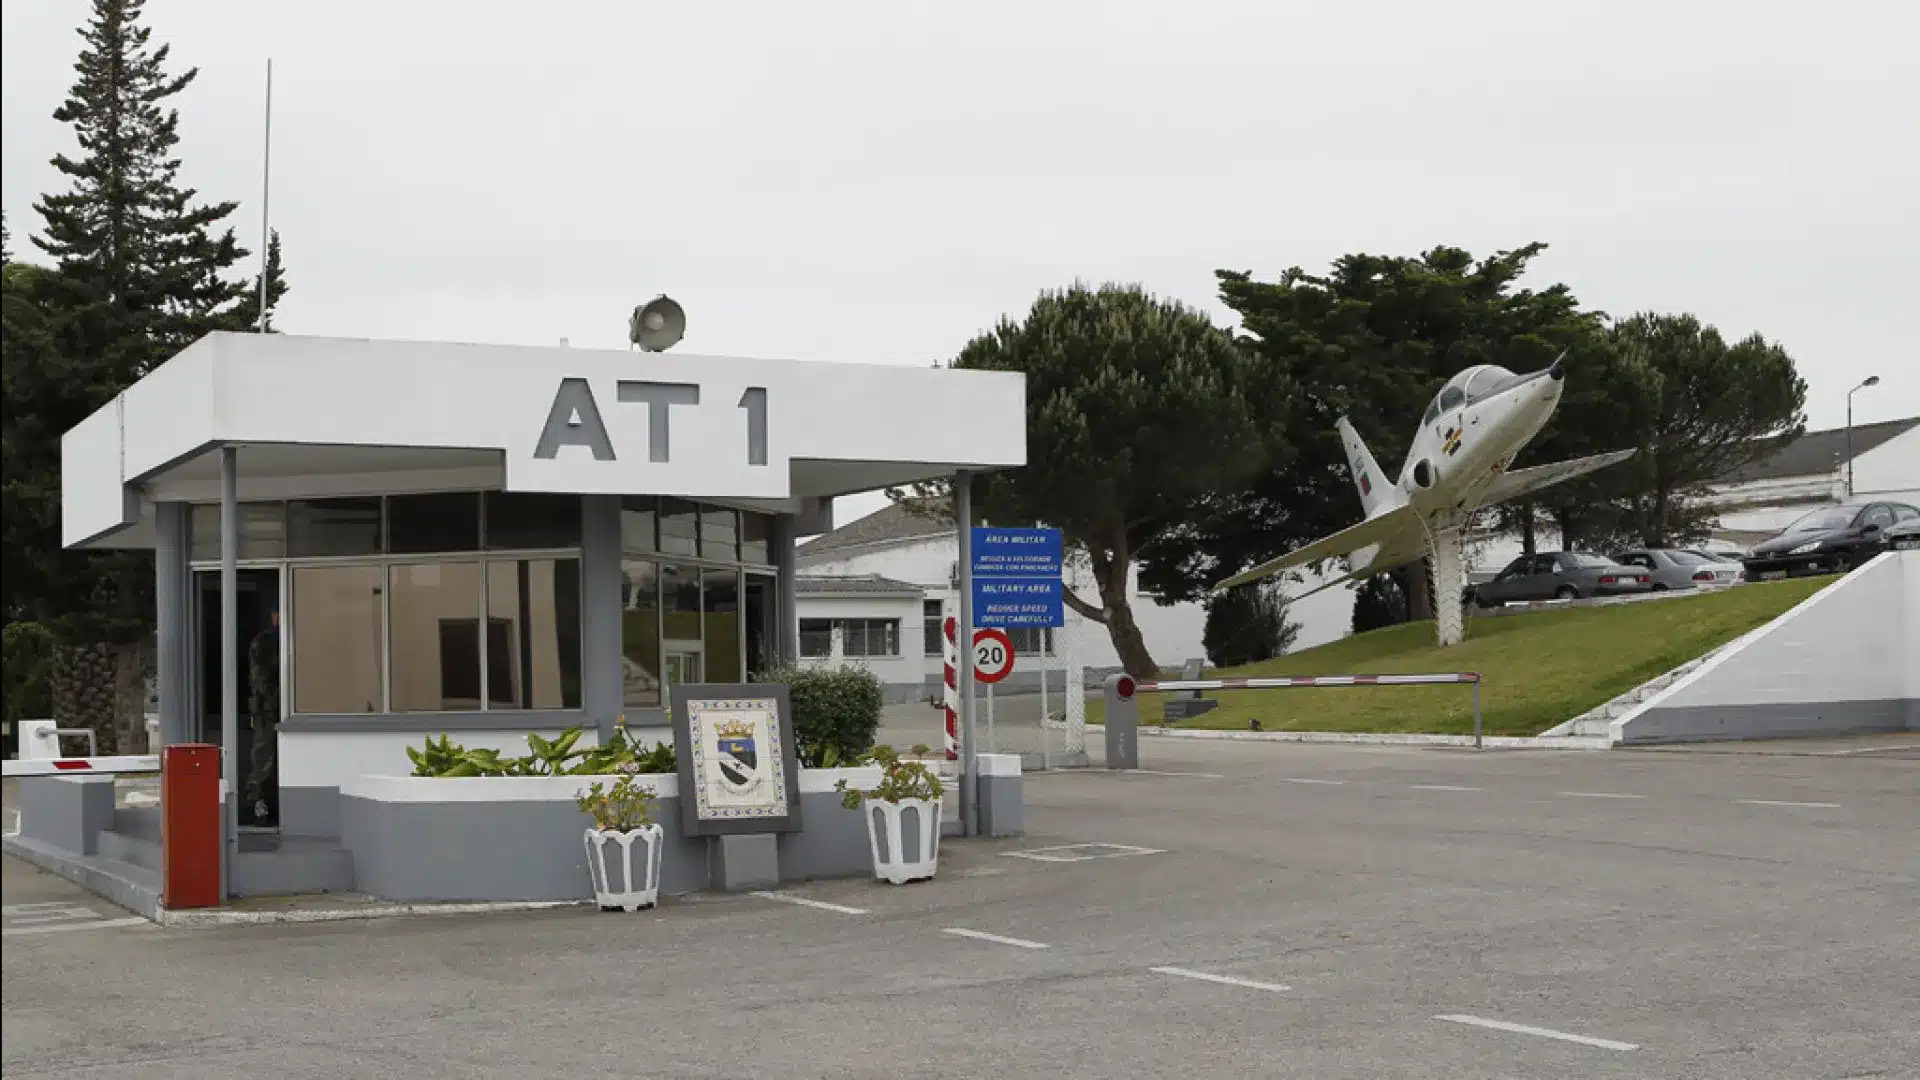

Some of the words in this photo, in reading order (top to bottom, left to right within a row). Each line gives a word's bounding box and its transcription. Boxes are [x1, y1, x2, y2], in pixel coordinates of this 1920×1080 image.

[533, 377, 700, 463] AT
[738, 386, 768, 467] 1
[982, 584, 1025, 593] MILITARY
[1027, 584, 1052, 593] AREA
[1021, 603, 1048, 613] SPEED
[977, 646, 1004, 665] 20
